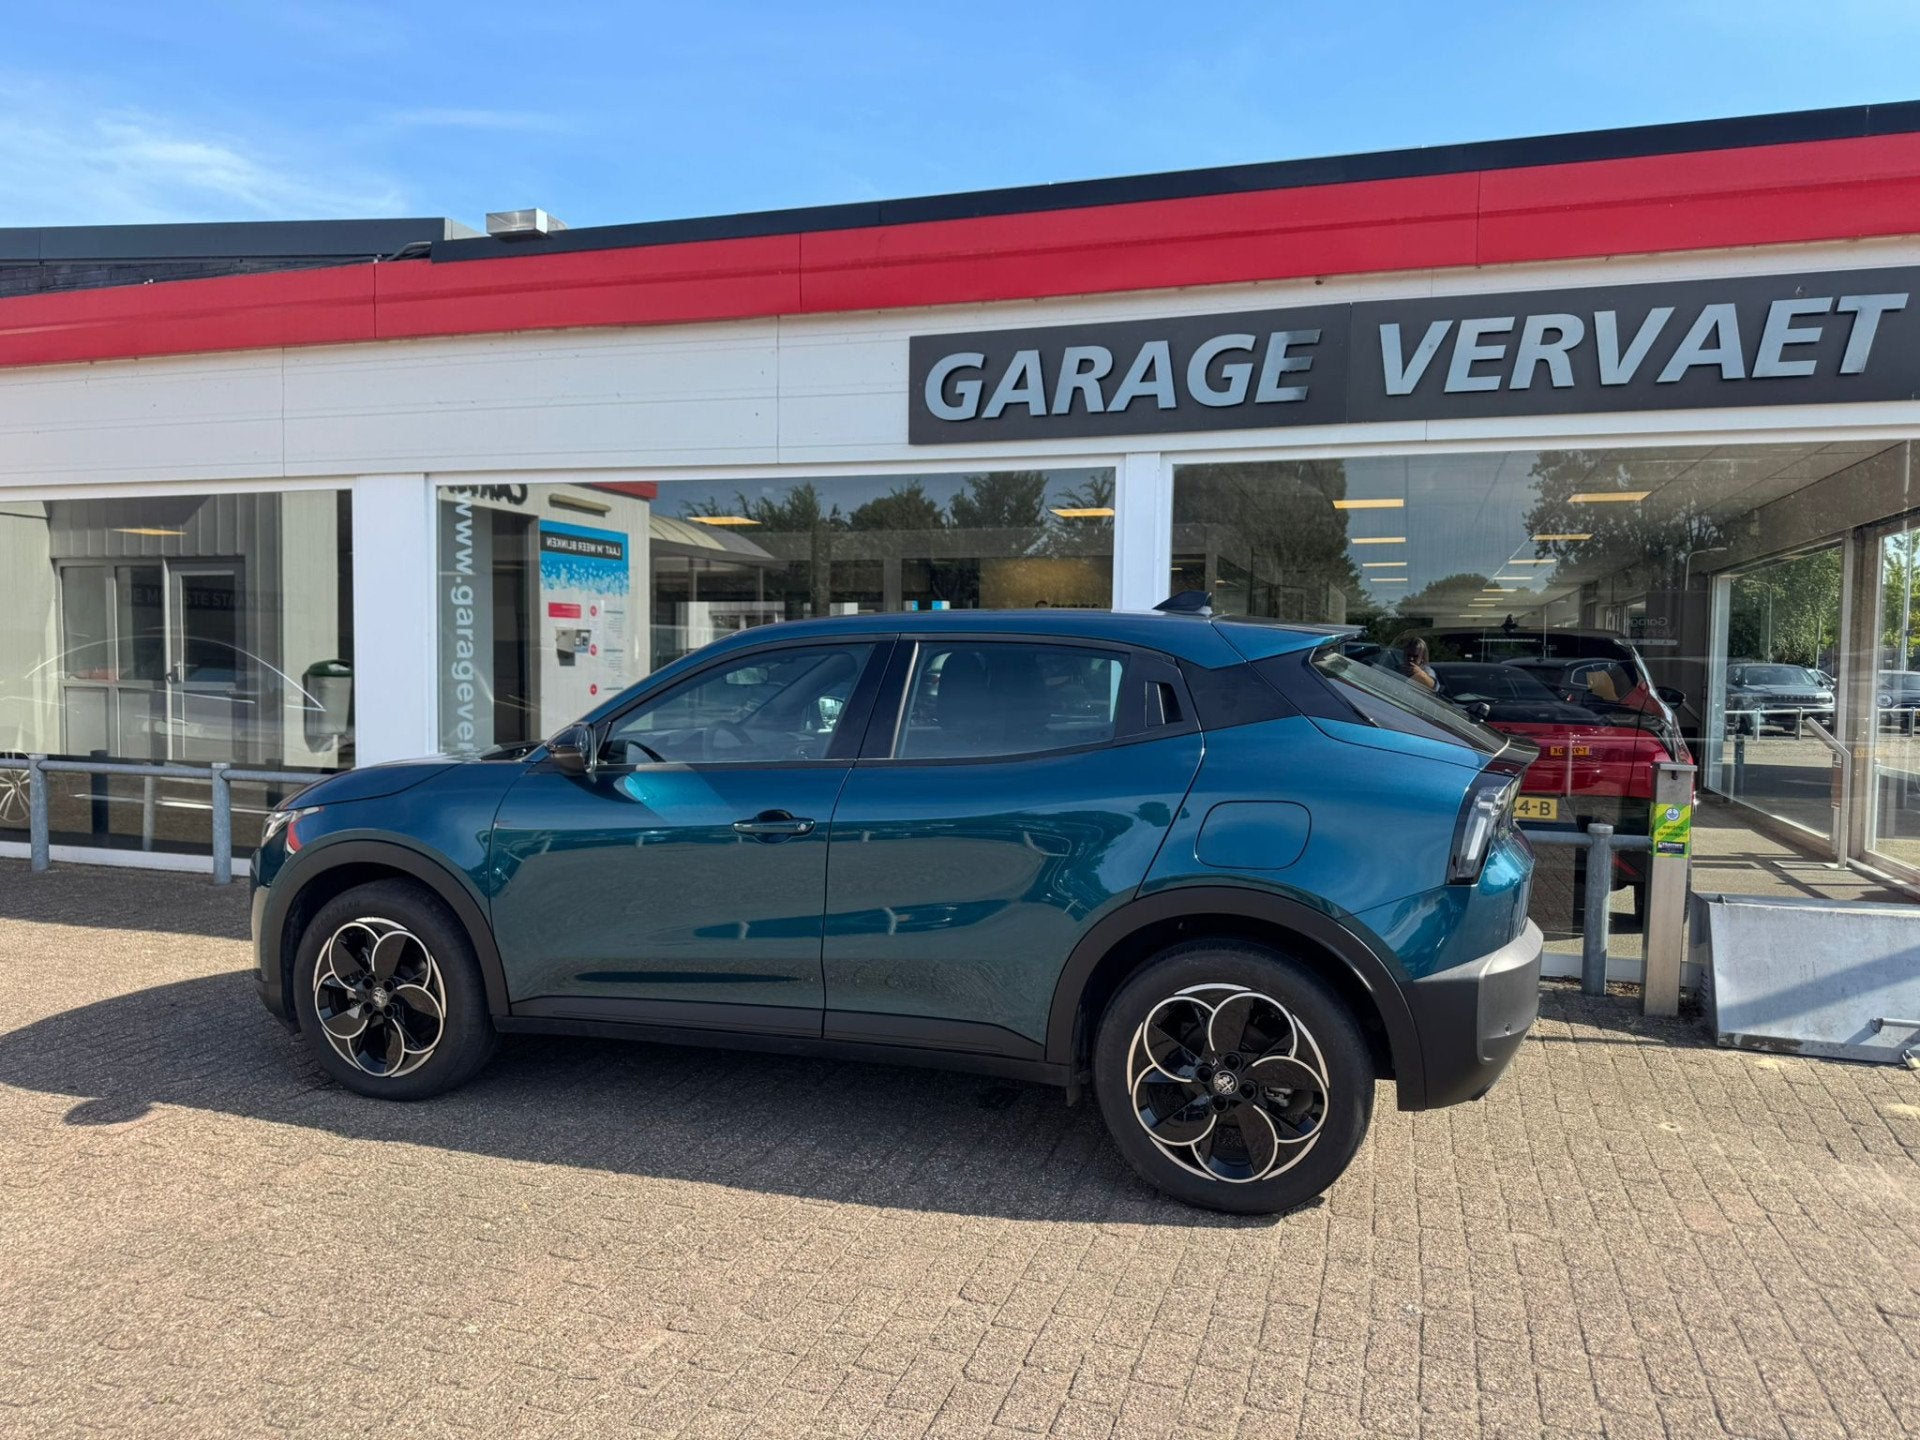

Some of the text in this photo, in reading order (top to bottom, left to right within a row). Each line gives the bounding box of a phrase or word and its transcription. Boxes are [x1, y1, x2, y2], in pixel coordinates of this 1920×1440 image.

[924, 293, 1909, 421] GARAGE VERVAET
[1512, 799, 1551, 817] 4-B
